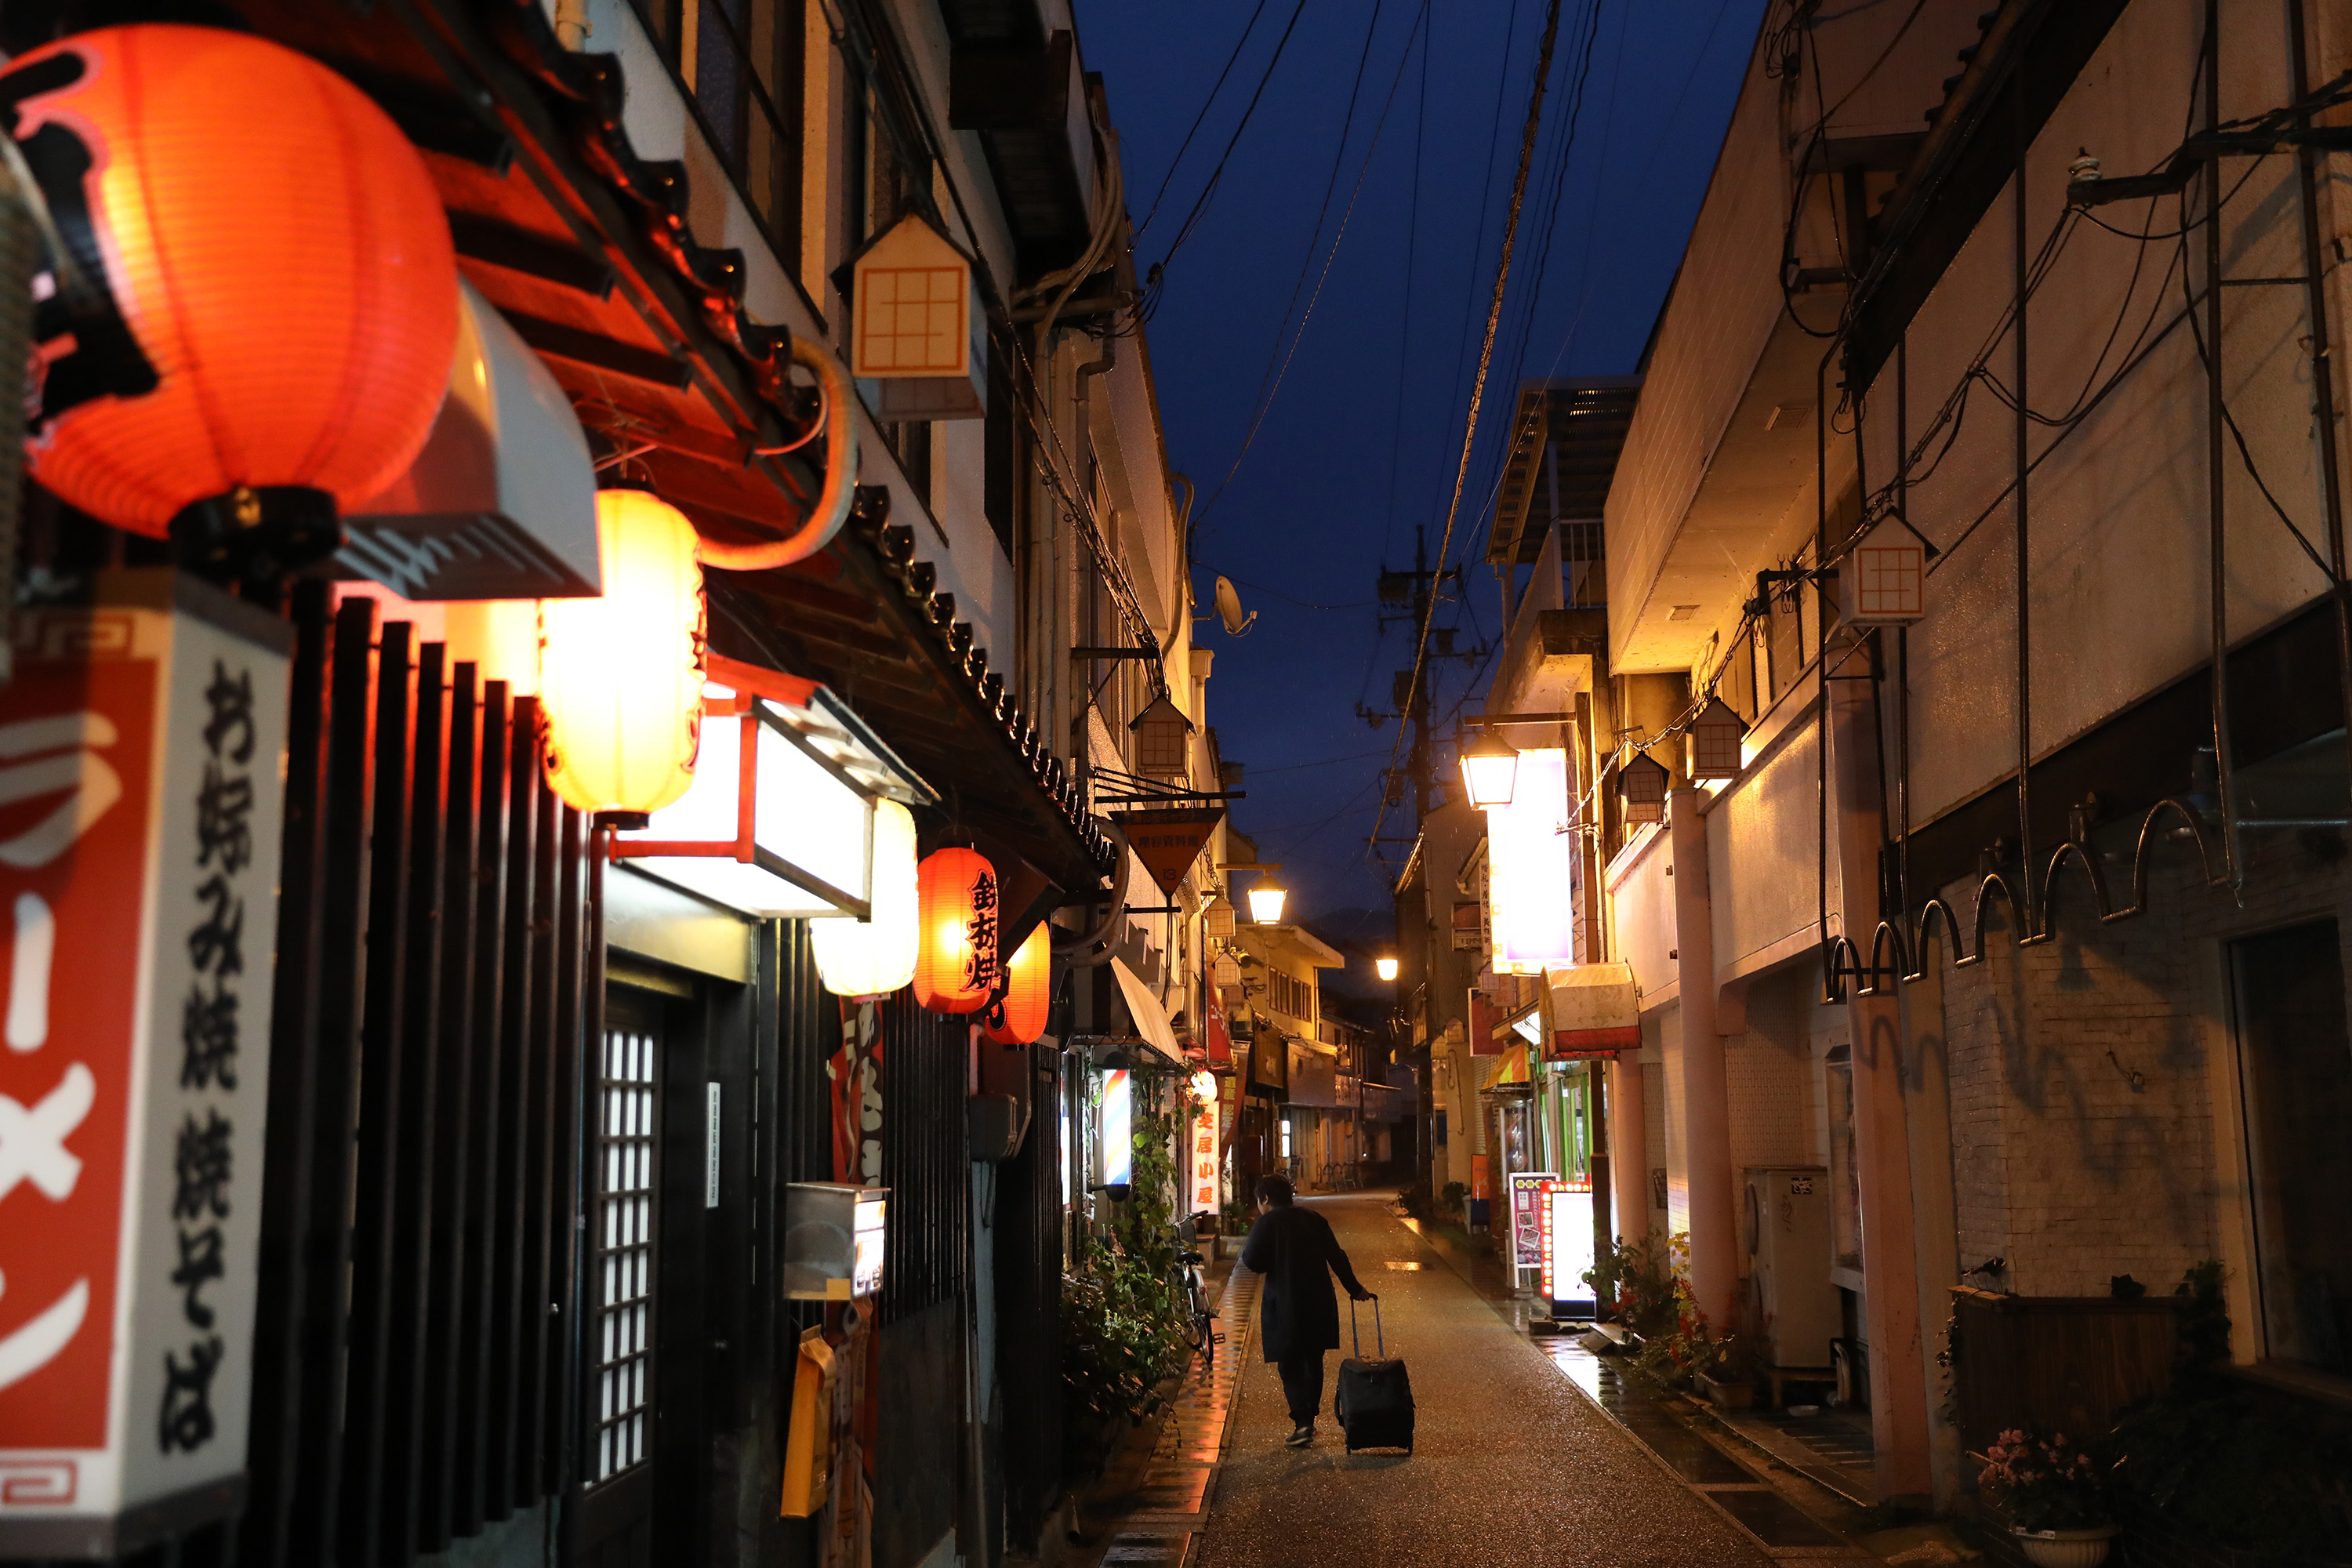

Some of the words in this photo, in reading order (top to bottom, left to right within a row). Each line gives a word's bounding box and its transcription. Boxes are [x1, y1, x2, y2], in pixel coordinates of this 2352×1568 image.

[1162, 868, 1177, 880] 13
[1196, 1112, 1214, 1204] 芝居小屋
